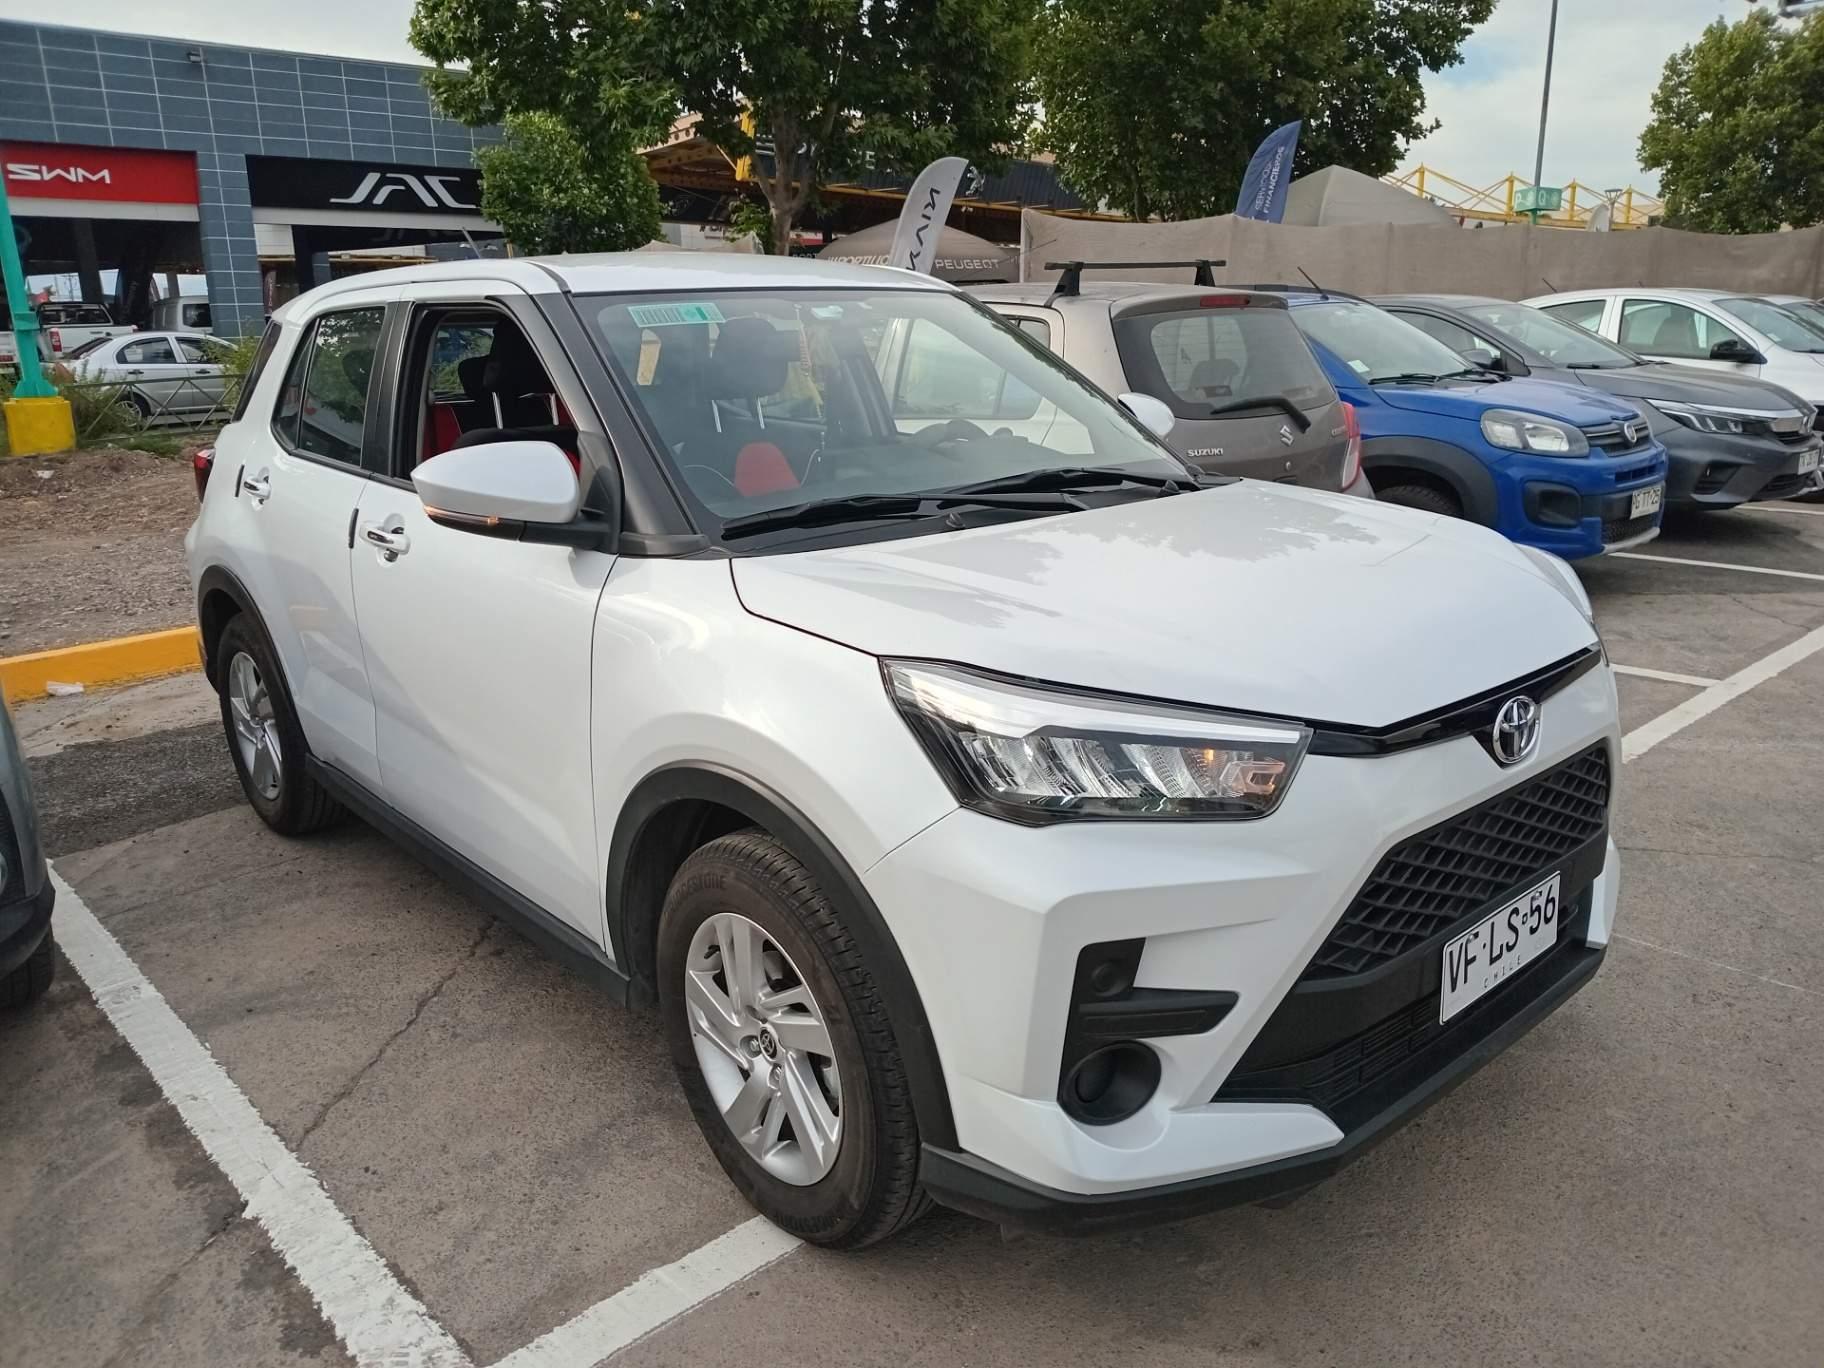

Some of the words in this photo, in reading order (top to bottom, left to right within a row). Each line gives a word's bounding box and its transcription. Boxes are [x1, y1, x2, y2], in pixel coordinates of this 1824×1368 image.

[6, 163, 111, 184] SWM
[1263, 145, 1285, 214] FINANCIEROS
[329, 172, 477, 209] JAC
[935, 259, 999, 269] PEUGEOT
[1187, 447, 1224, 457] SUZUKI
[1483, 954, 1522, 989] CHILE
